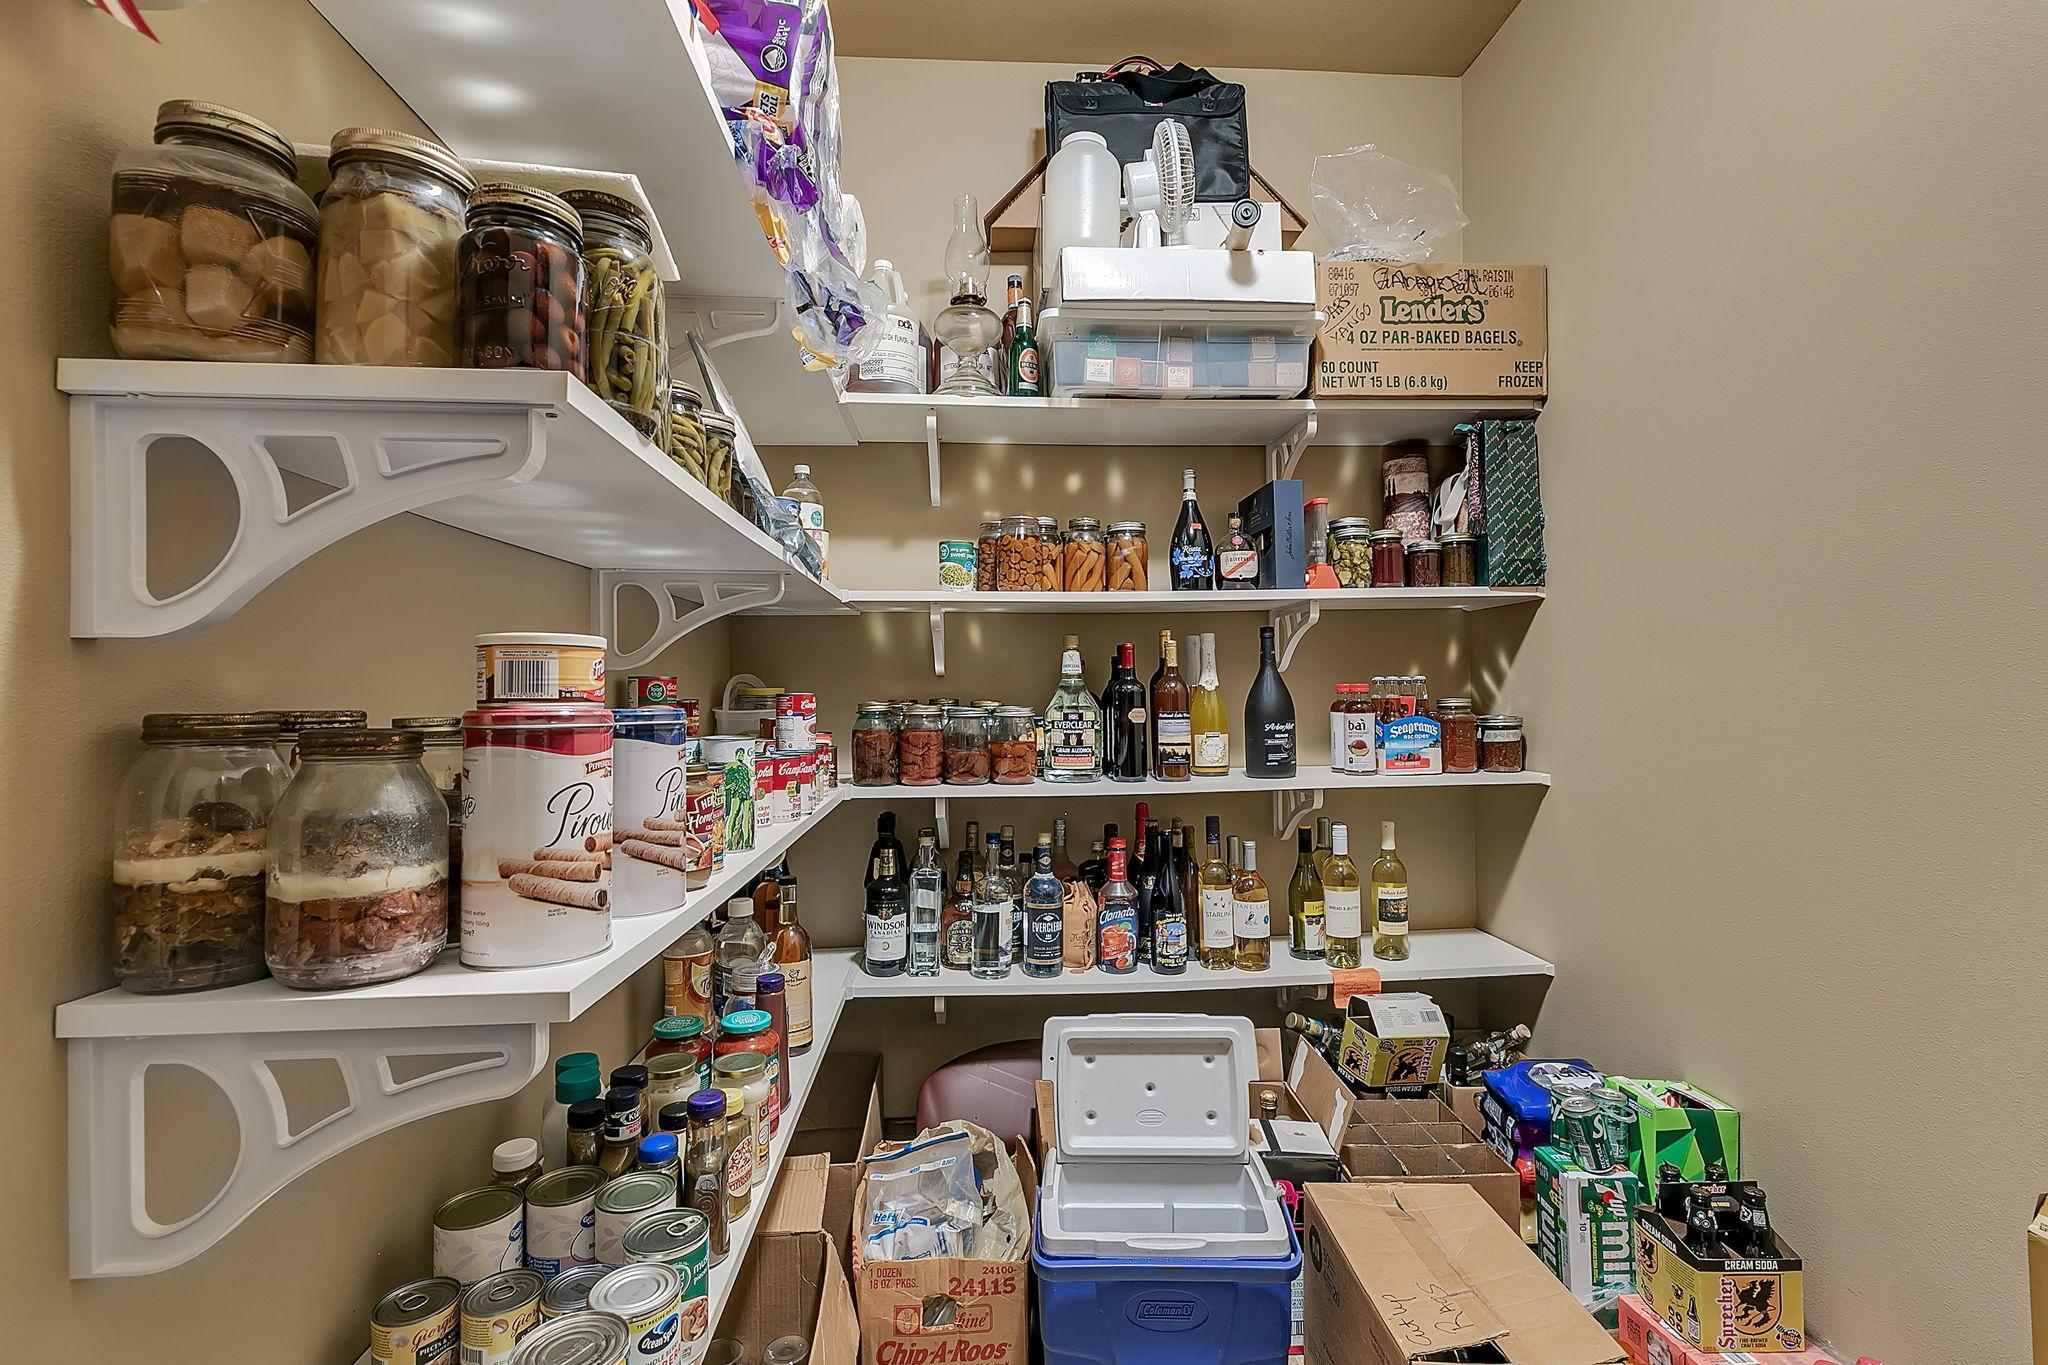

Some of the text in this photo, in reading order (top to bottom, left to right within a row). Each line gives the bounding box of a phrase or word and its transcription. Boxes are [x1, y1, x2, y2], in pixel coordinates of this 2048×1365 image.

[772, 19, 787, 45] SEPTIC
[779, 26, 791, 47] SAFE
[1380, 296, 1485, 324] Lender's
[1346, 331, 1355, 344] 4
[1360, 331, 1377, 344] OZ
[1382, 331, 1459, 344] PAR-BAKED
[1321, 361, 1379, 373] 60 COUNT
[1514, 361, 1543, 373] KEEP
[1322, 376, 1448, 389] NET WT 15 LB (6.8 kg)
[1498, 376, 1543, 388] FROZEN
[1054, 721, 1093, 730] EVERCLEAR
[1348, 719, 1366, 730] bai
[1390, 722, 1438, 739] Seagram's
[1072, 747, 1092, 755] ALCOHOL
[544, 781, 612, 848] Pirou
[1100, 907, 1135, 925] Clamato
[868, 920, 905, 931] WINDSOR
[1032, 921, 1062, 932] EVERCLEAR
[1418, 1038, 1438, 1081] Sprecher
[1579, 1222, 1587, 1231] 10
[1641, 1219, 1678, 1254] CREAM SODA
[1725, 1261, 1778, 1270] CREAM SODA
[877, 1268, 902, 1277] DOZEN
[869, 1279, 919, 1290] 18 OZ. PKGS.
[949, 1277, 1017, 1297] 24115
[1143, 1303, 1181, 1317] Coleman
[1717, 1276, 1738, 1350] Sprecher
[648, 1313, 665, 1326] RECIPE
[419, 1340, 440, 1356] PIECES
[641, 1335, 663, 1350] Ocean
